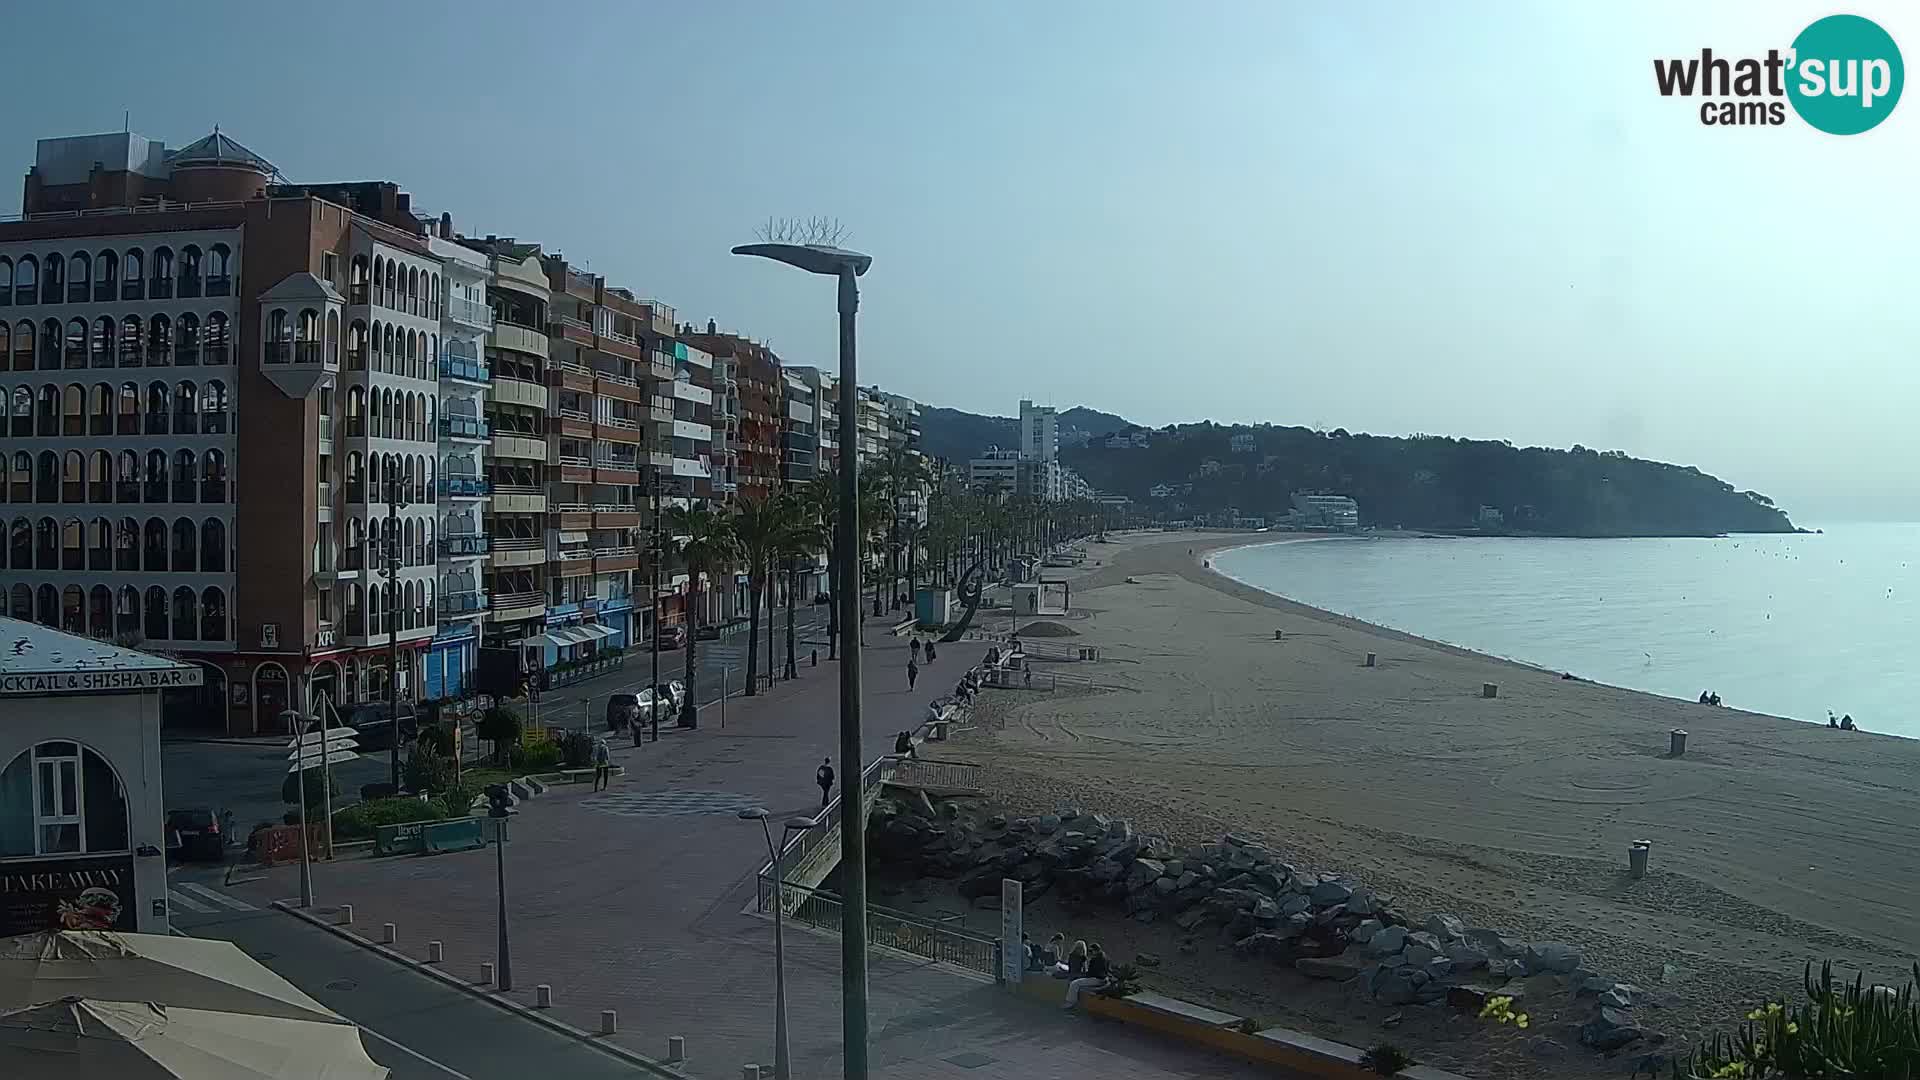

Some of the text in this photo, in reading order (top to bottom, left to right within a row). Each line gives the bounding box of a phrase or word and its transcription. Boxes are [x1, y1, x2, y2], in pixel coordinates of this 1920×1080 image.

[318, 631, 336, 647] KFC
[0, 671, 182, 690] CKTAIL & SHISHA BAR
